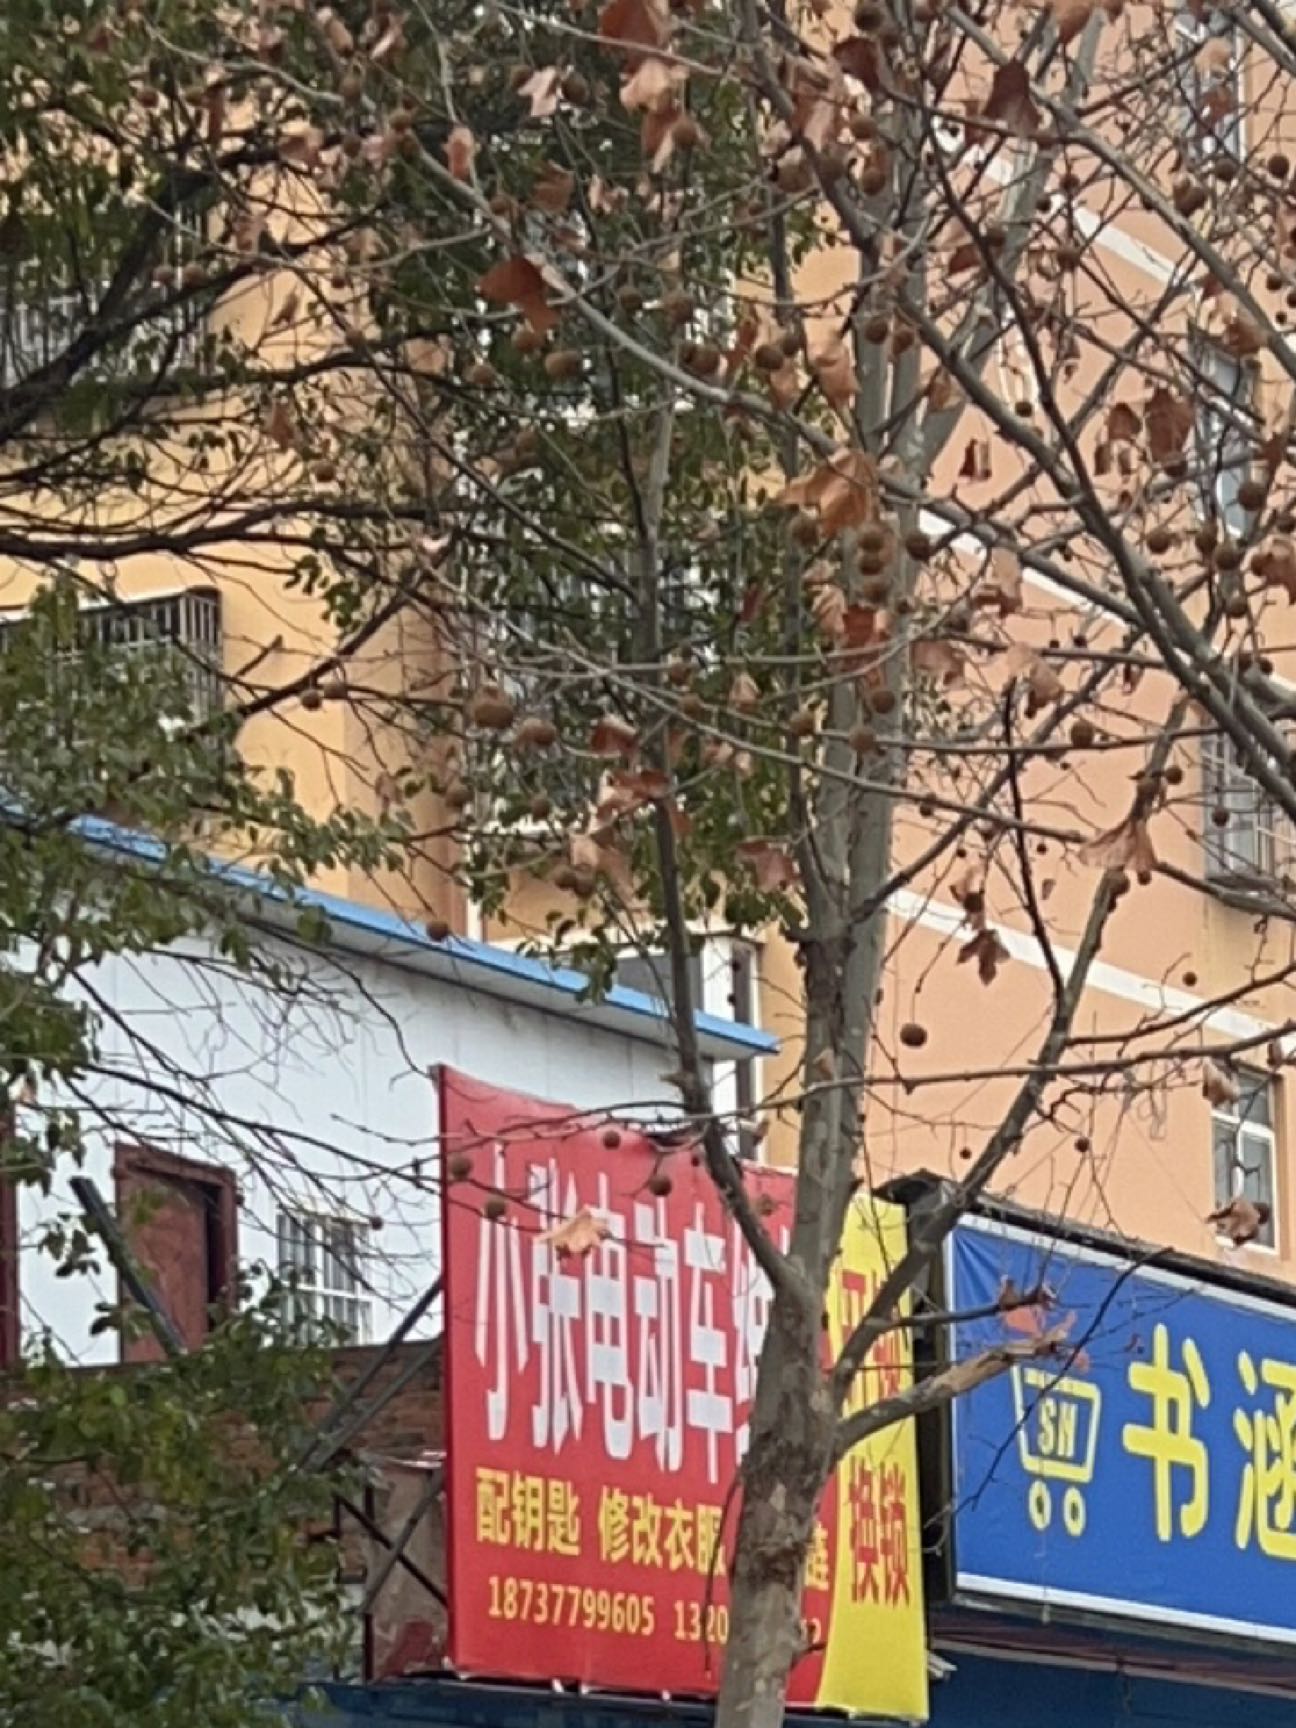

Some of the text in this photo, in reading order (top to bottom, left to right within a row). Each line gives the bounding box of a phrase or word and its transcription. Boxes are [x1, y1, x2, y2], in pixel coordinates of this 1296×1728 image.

[474, 1143, 790, 1485] 小张电动车
[475, 1467, 581, 1556] 配钥匙
[597, 1485, 727, 1577] 修改衣服
[487, 1575, 655, 1636] 18737799605
